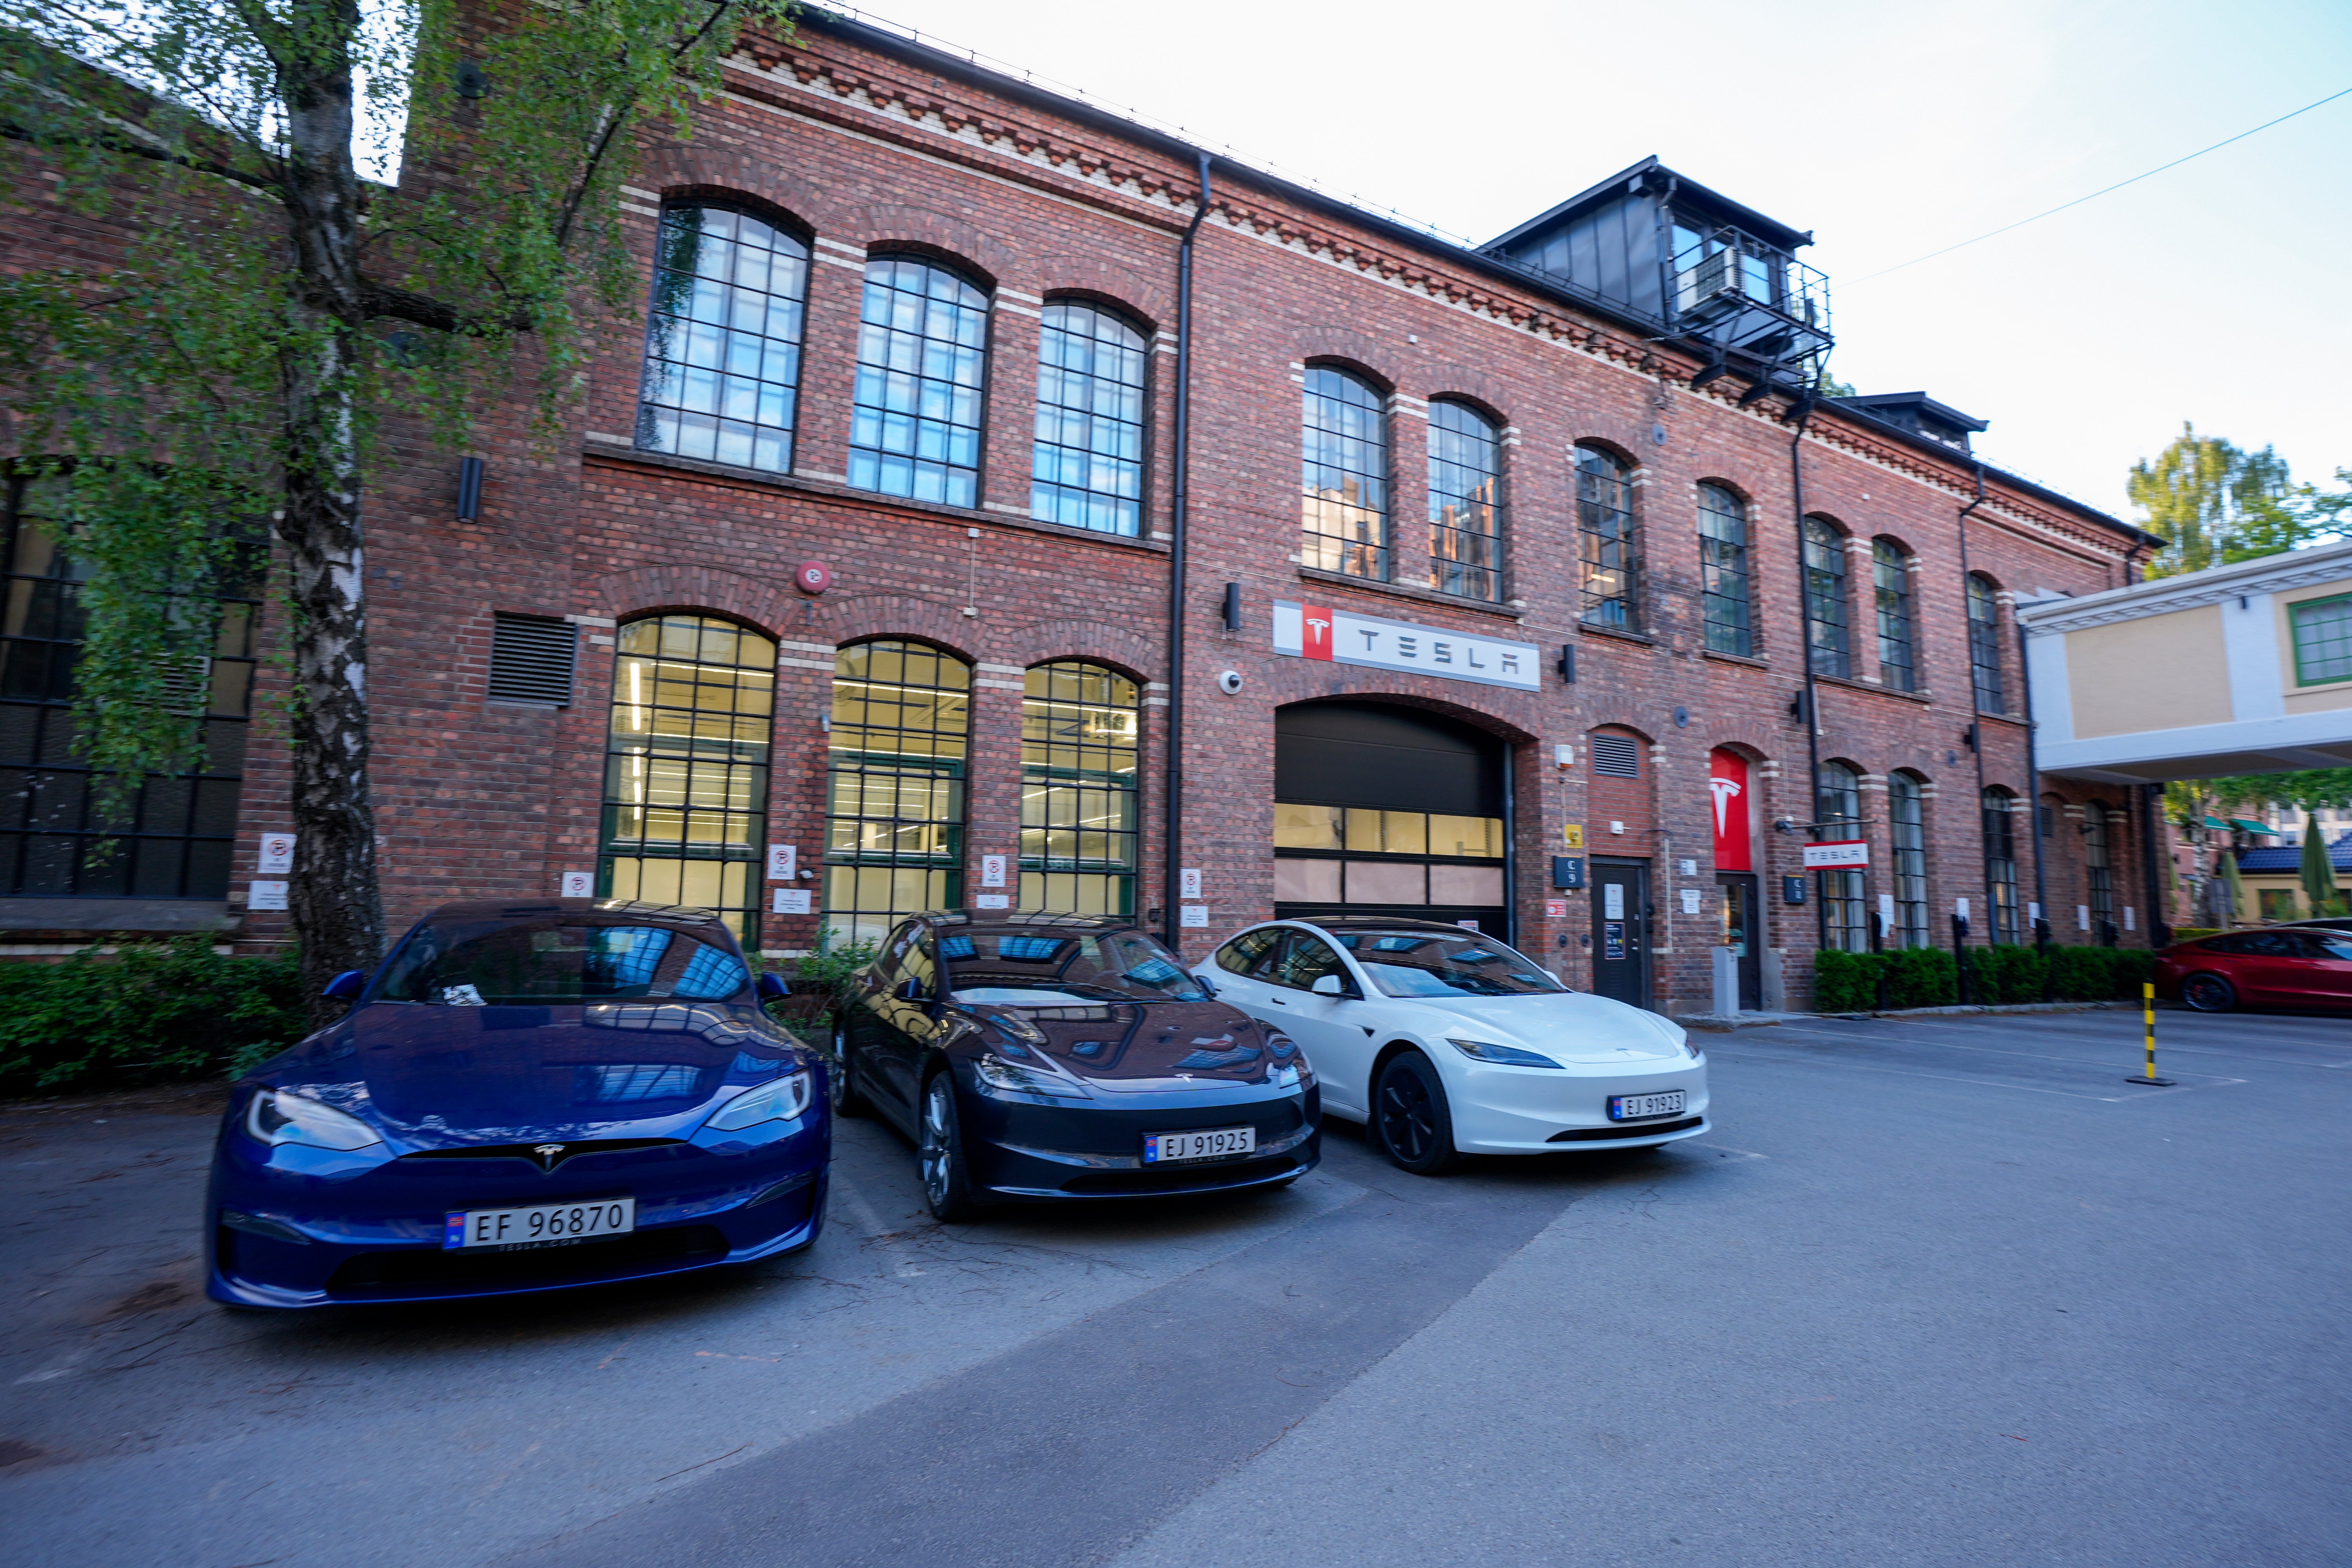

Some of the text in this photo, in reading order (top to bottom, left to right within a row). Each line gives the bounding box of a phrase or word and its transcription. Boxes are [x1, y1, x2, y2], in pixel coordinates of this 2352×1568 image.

[1358, 630, 1519, 674] TESLA
[1809, 850, 1860, 860] TESLA
[1567, 860, 1576, 870] C
[1568, 874, 1576, 883] 9
[1794, 880, 1802, 888] C
[1627, 1094, 1681, 1114] EJ 91923
[1166, 1131, 1248, 1157] EJ 91925
[476, 1204, 622, 1241] EF 96870
[499, 1238, 582, 1252] TESLA.COM
